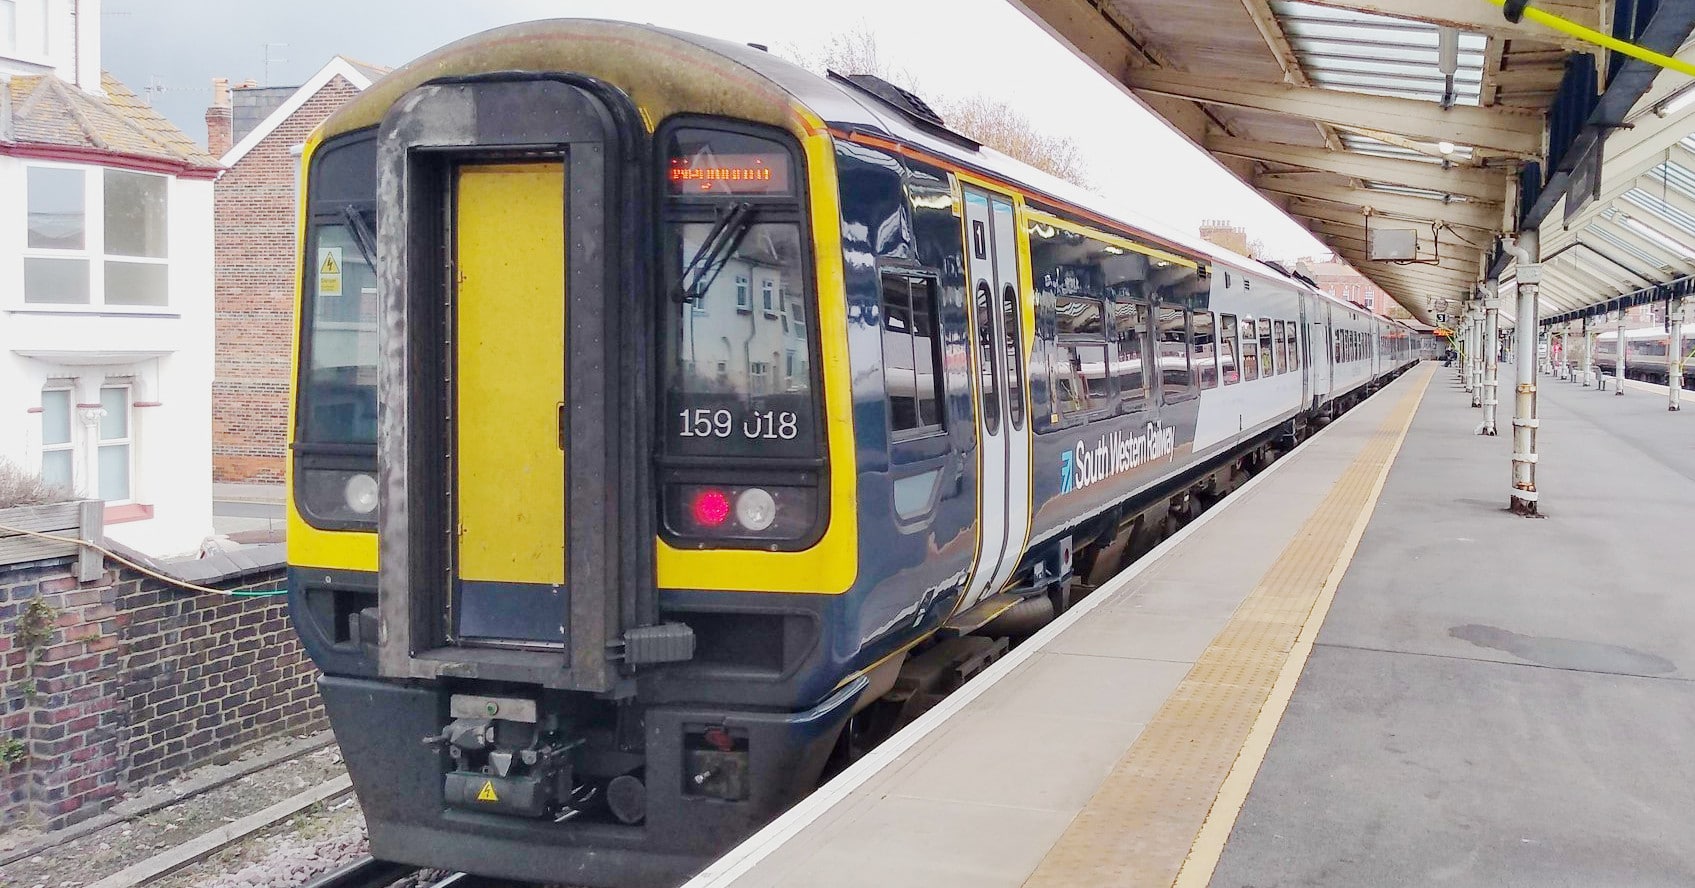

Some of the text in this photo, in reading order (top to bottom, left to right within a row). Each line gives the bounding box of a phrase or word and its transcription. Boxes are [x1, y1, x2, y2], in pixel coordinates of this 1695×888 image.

[976, 225, 983, 255] 1
[679, 408, 798, 439] 159 018
[1075, 419, 1175, 490] South Western Railway
